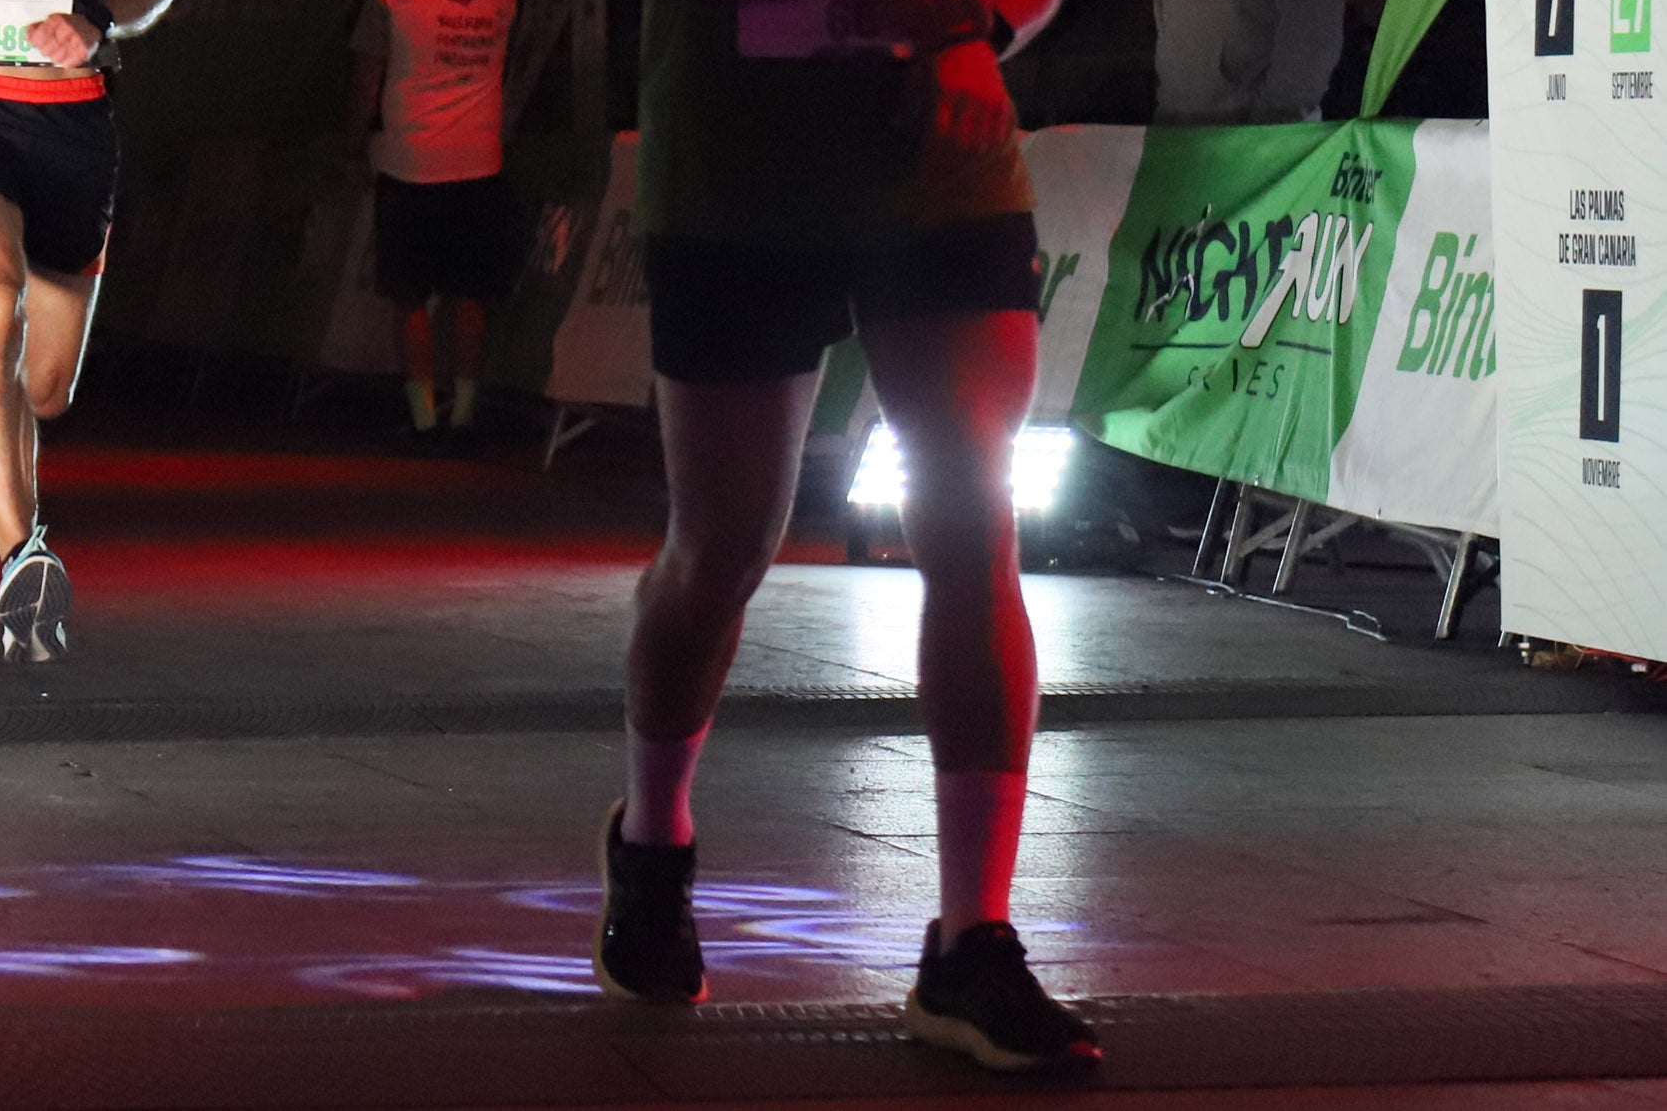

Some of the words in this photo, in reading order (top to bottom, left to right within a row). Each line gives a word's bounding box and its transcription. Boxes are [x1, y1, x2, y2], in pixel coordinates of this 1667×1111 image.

[1546, 73, 1566, 101] JUNIO
[1612, 71, 1653, 100] SEPTIEMBRE
[1570, 189, 1586, 220] LAS
[1589, 190, 1624, 221] PALMAS
[1559, 233, 1569, 263] DE
[1572, 234, 1596, 264] GRAN
[1598, 235, 1636, 266] CANARIA
[1597, 314, 1606, 421] 1
[1583, 457, 1621, 489] NOVIEMBRE
